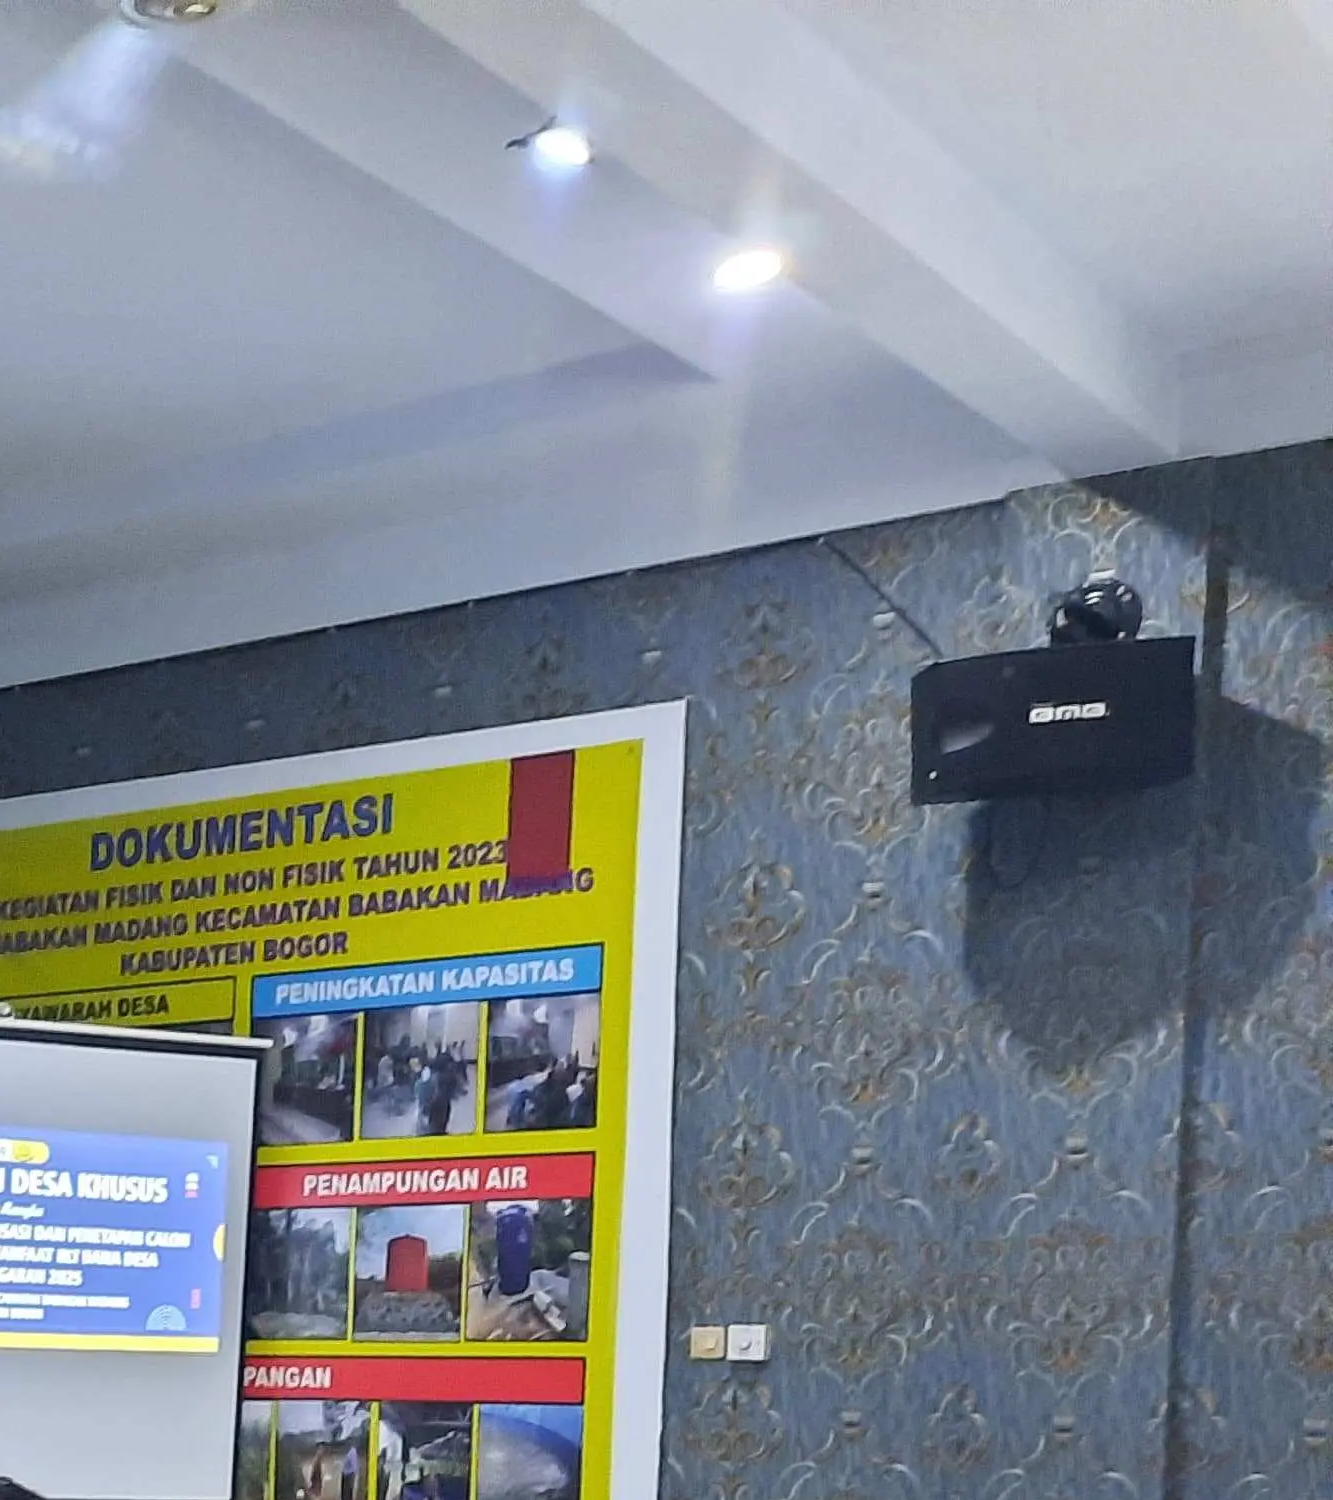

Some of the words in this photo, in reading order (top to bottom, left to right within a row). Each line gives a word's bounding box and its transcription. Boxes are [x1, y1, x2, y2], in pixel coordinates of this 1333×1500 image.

[89, 791, 395, 873] DOKUMENTASI
[105, 880, 164, 909] FISIK
[171, 875, 216, 901] DAN
[223, 867, 275, 896] NON
[283, 858, 346, 888] FISIK
[354, 848, 439, 880] TAHUN
[447, 839, 508, 870] 2023
[94, 912, 188, 945] MADANG
[196, 896, 341, 934] KECAMATAN
[348, 880, 470, 918] BABAKAN
[120, 940, 255, 977] KABUPATEN
[262, 931, 349, 963] BOGOR
[275, 972, 434, 1005] PENINGKATAN
[441, 957, 575, 991] KAPASITAS
[117, 993, 170, 1018] DESA
[11, 1168, 73, 1198] DESA
[77, 1172, 169, 1203] KHUSUS
[302, 1166, 480, 1198] PENAMPUNGAN
[484, 1165, 528, 1190] AIR
[242, 1366, 331, 1389] PANGAN
